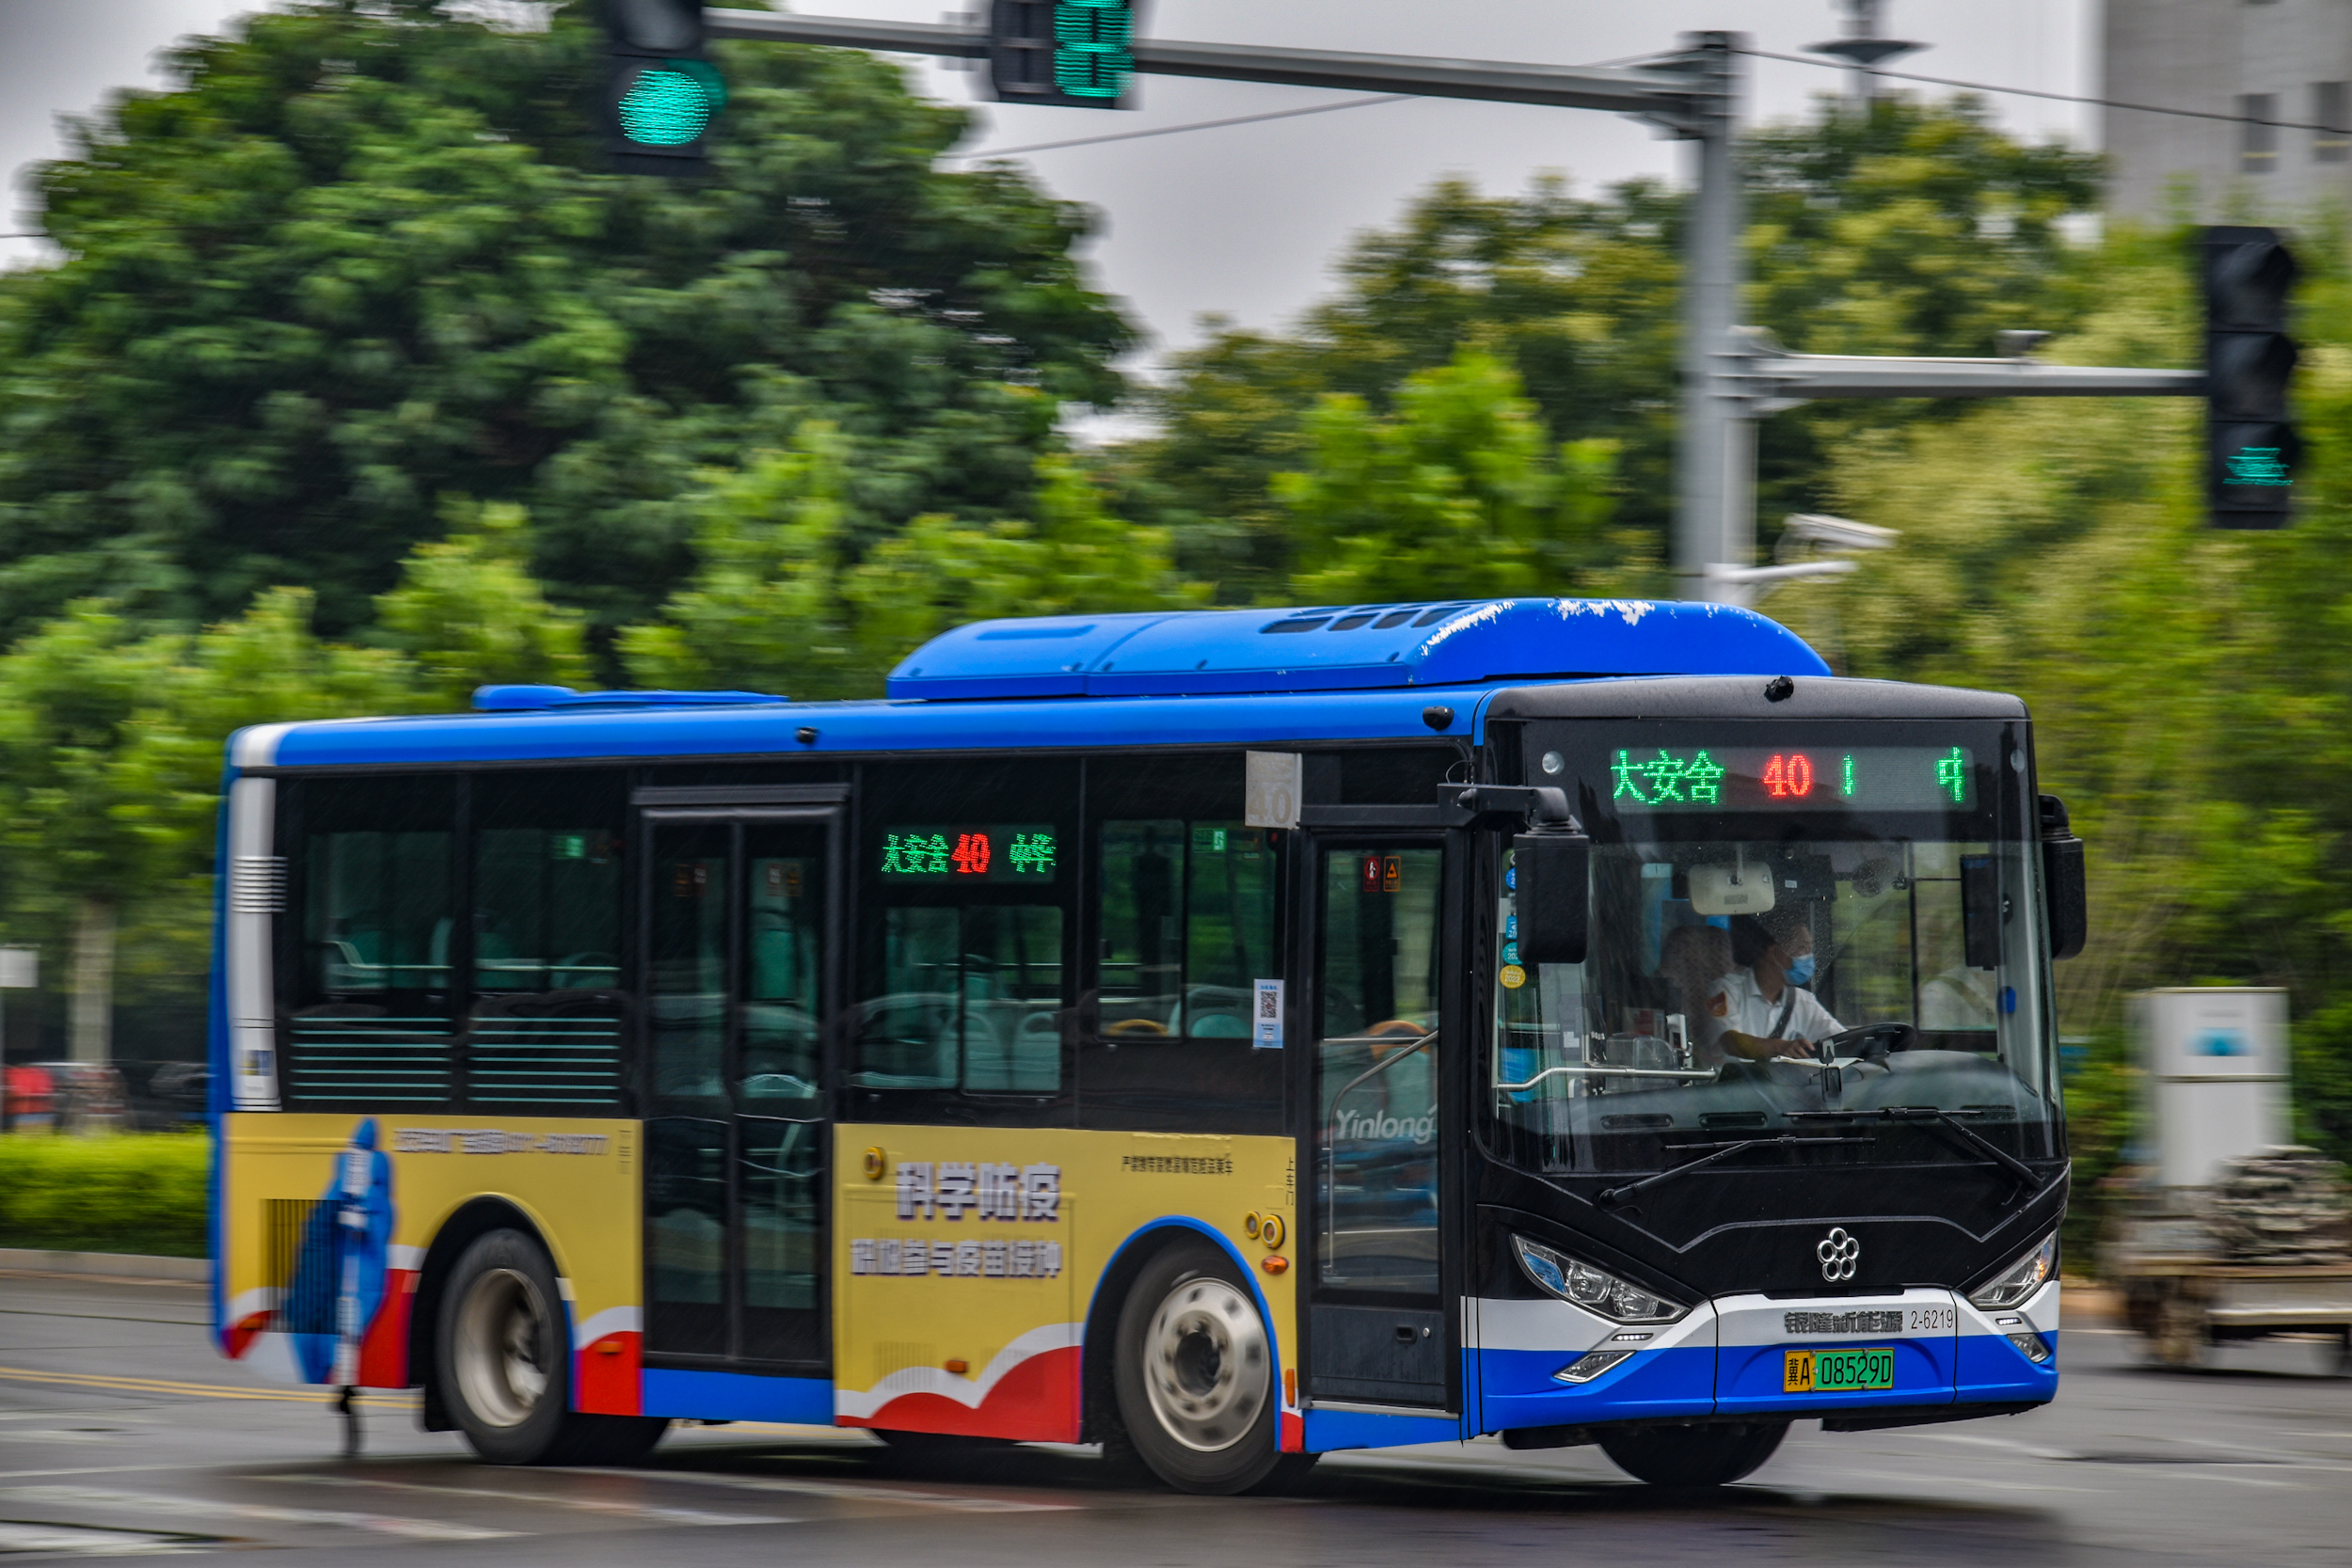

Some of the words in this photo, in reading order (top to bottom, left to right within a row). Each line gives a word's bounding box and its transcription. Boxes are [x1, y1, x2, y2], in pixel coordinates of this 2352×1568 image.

[1610, 749, 1724, 805] 大安舍
[1762, 753, 1812, 796] 40
[882, 833, 949, 874] 大安舍
[951, 833, 991, 874] 40
[1336, 1109, 1435, 1145] Yinlong
[896, 1162, 1062, 1221] 科学防疫
[1785, 1310, 1903, 1334] 银隆新能源
[1911, 1308, 1954, 1330] 2-6219
[1788, 1357, 1810, 1386] 冀A
[1821, 1354, 1892, 1385] 08529D
